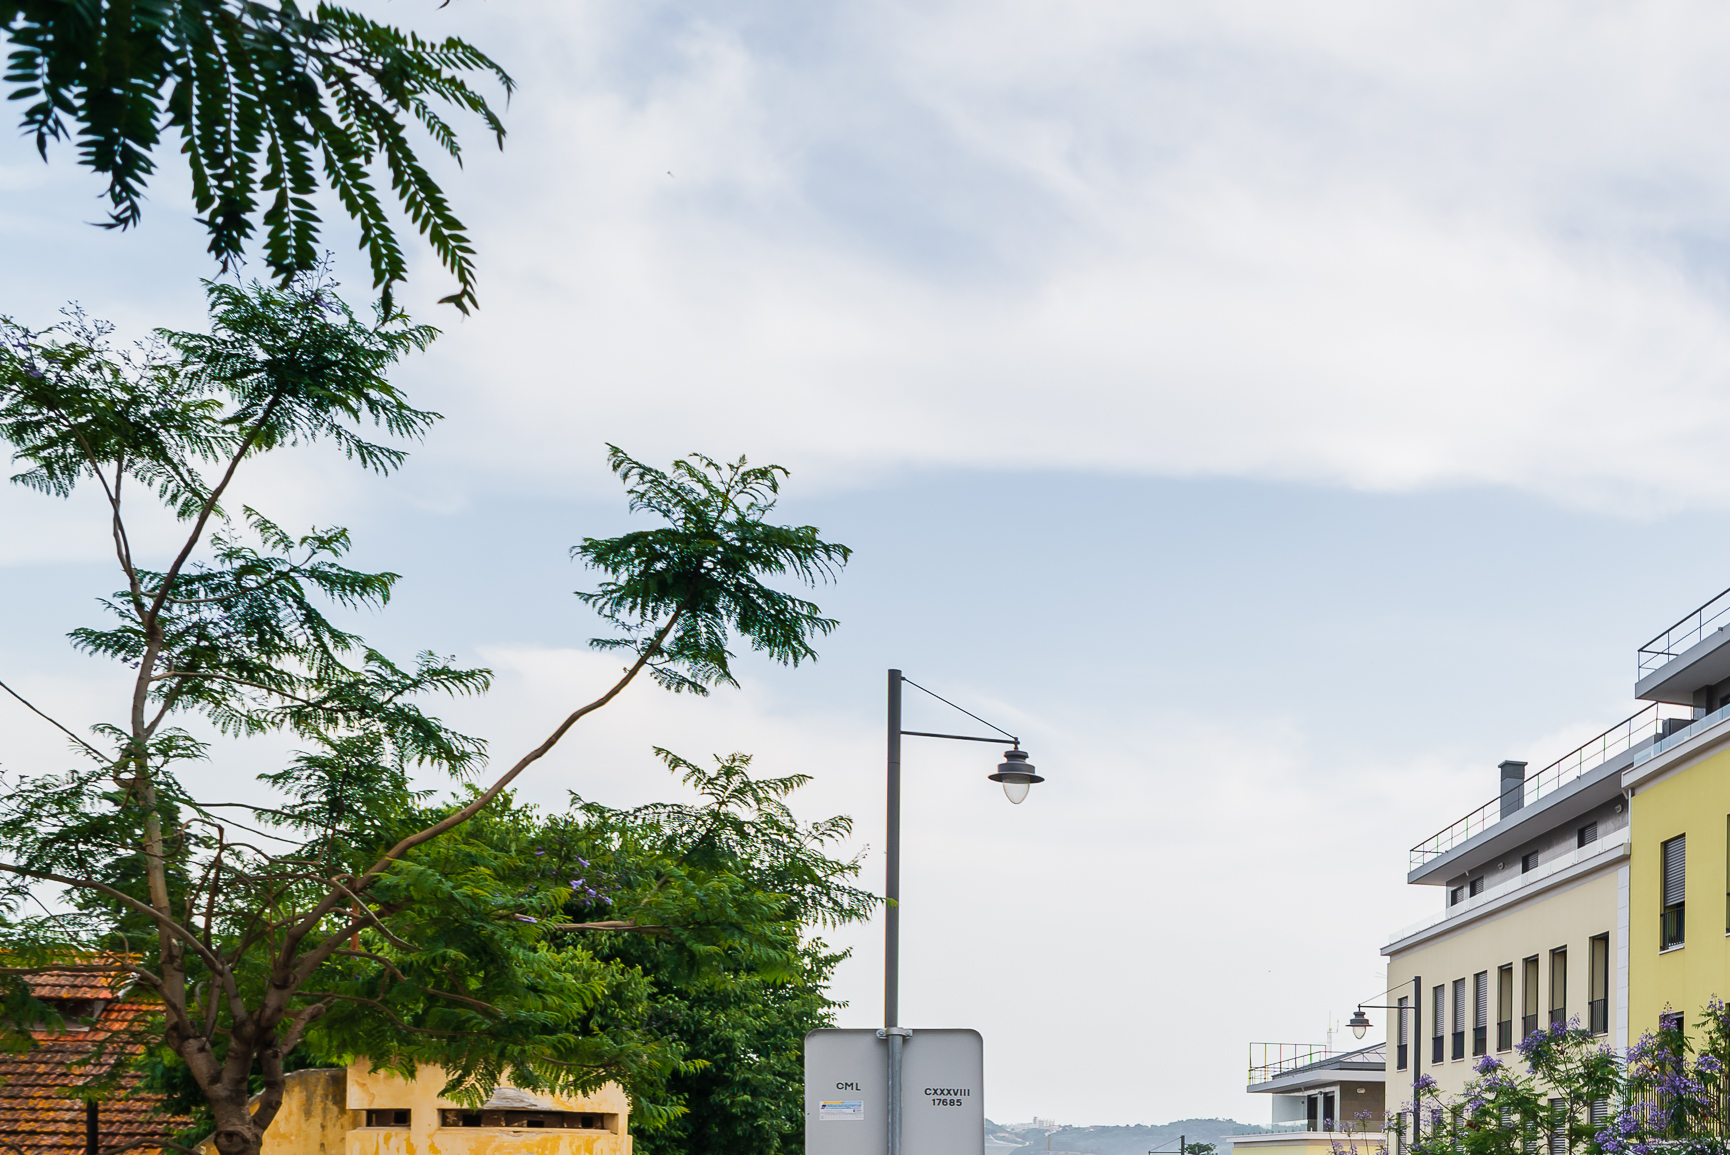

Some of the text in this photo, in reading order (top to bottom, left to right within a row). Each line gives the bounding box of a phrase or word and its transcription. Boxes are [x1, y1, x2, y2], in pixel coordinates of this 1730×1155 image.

[835, 1082, 862, 1091] CML
[923, 1087, 971, 1097] CXXXVIII
[931, 1098, 963, 1107] 17685
